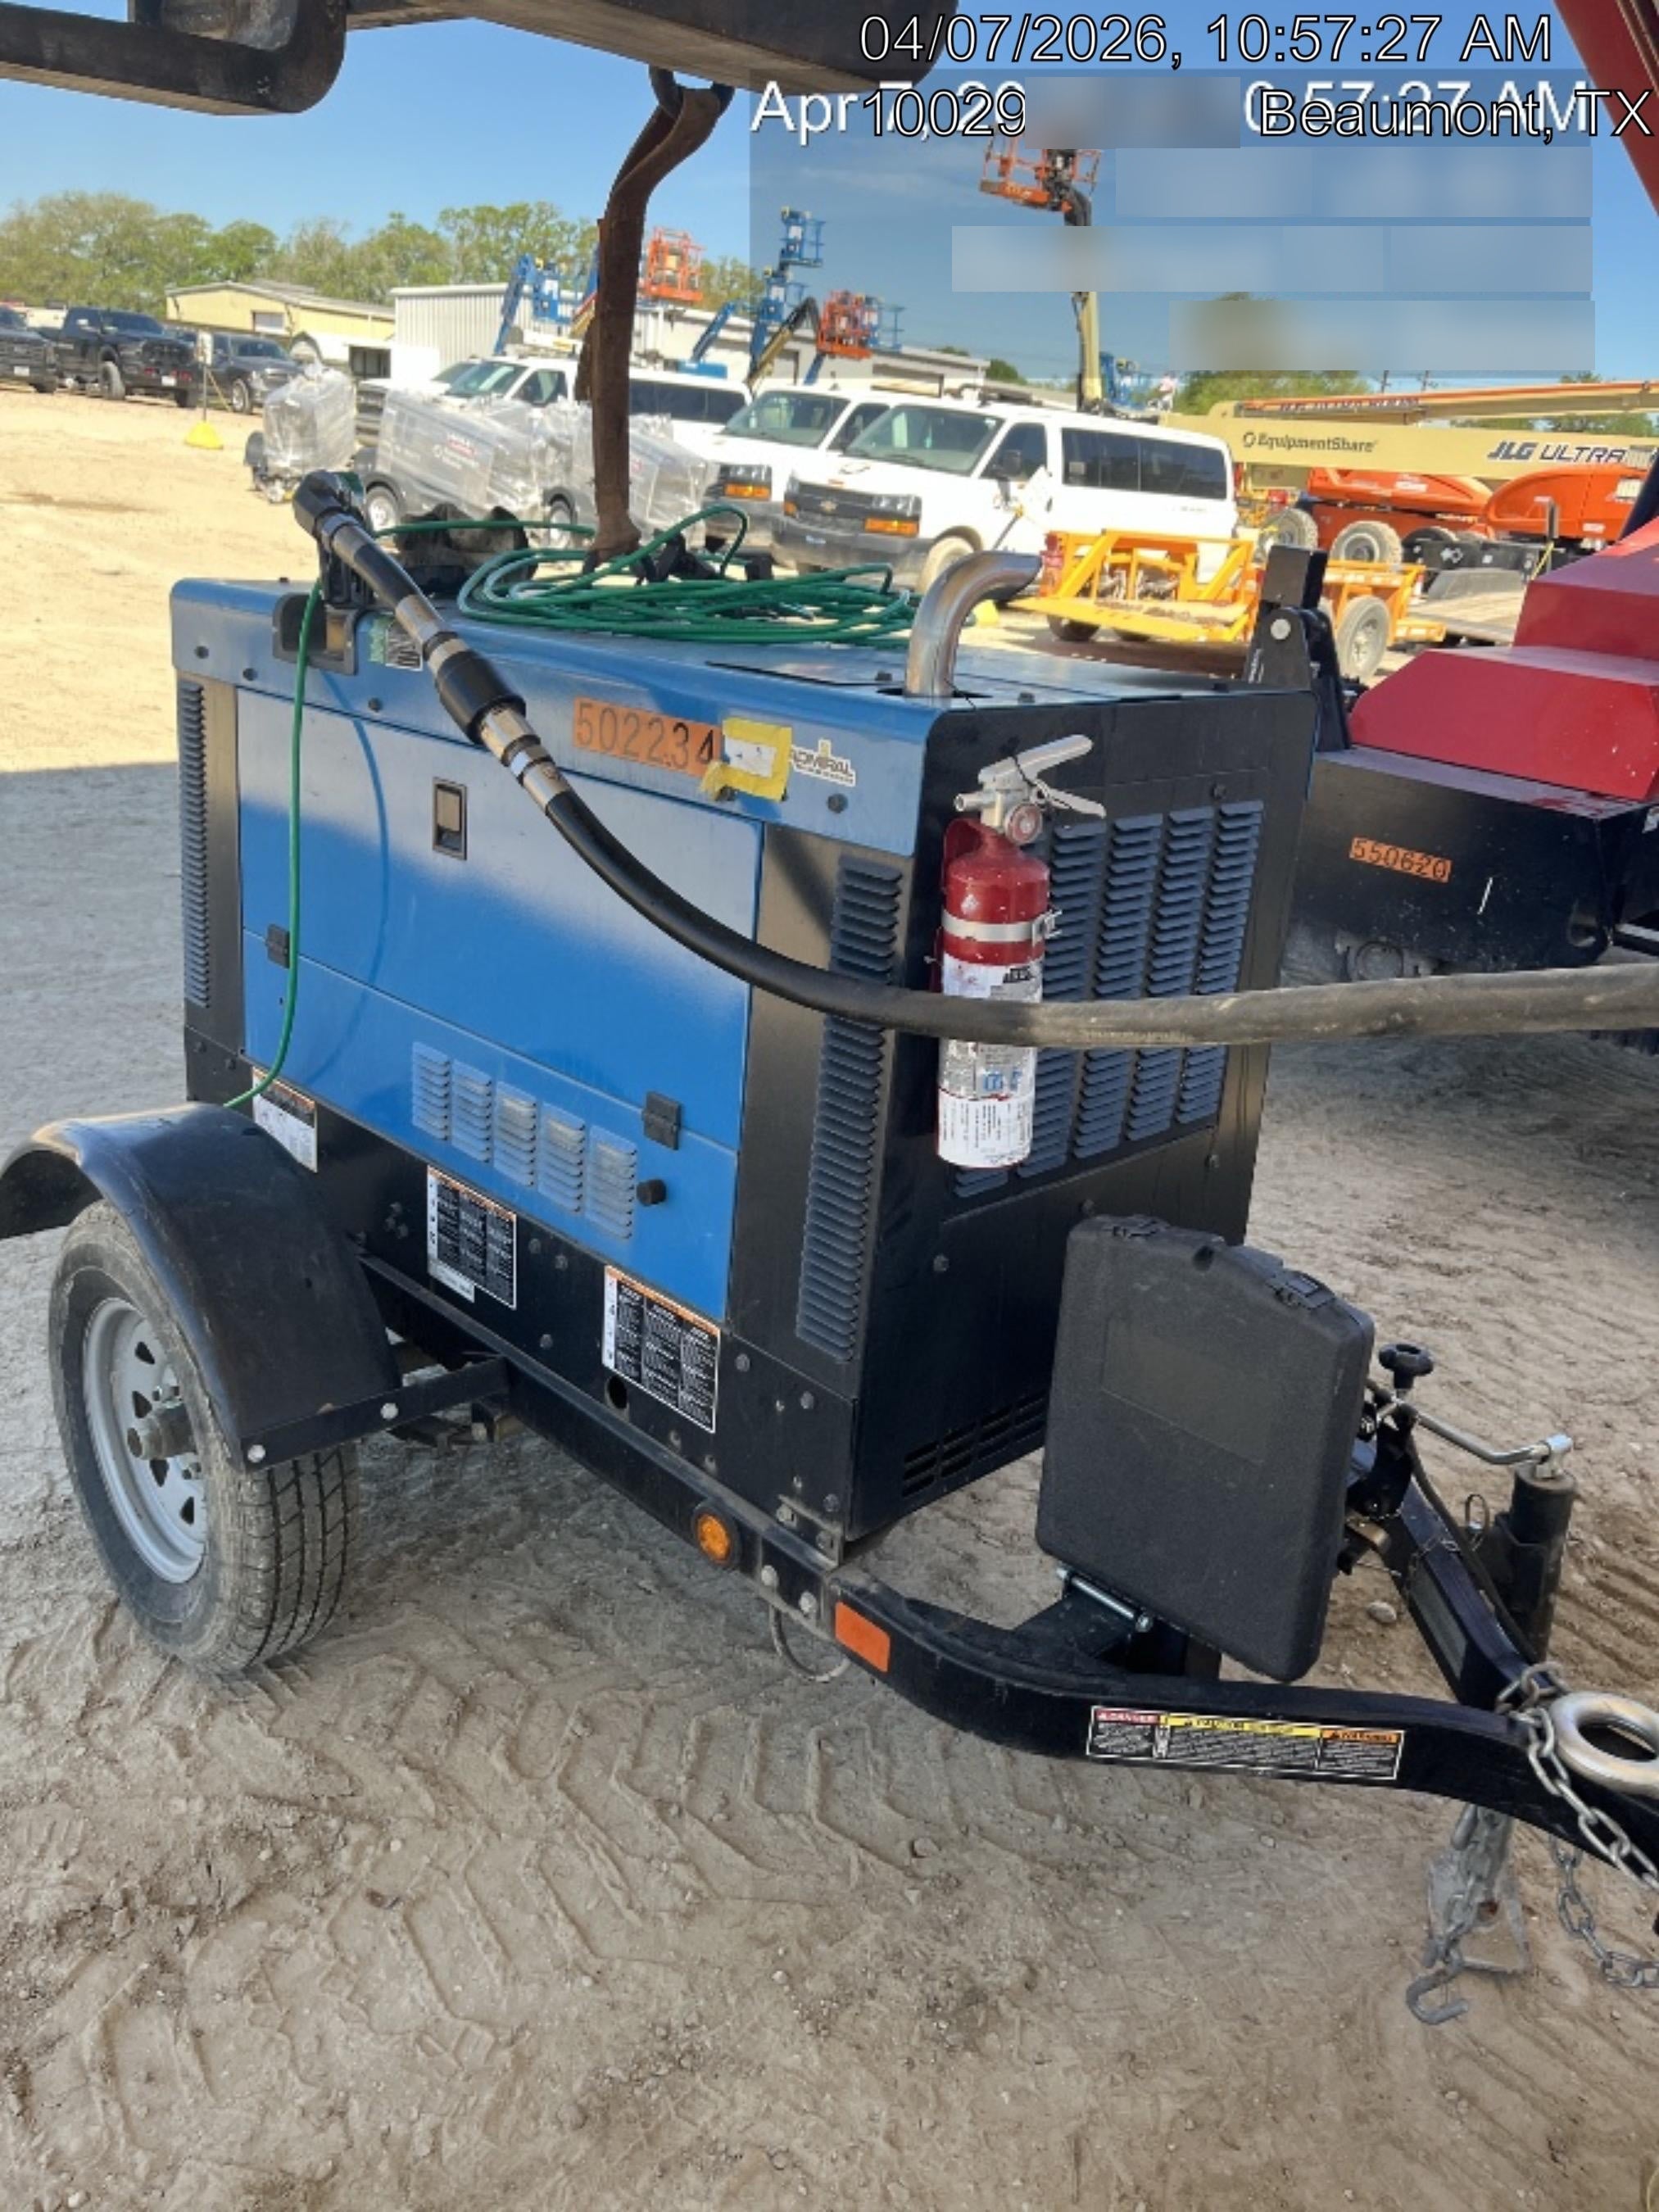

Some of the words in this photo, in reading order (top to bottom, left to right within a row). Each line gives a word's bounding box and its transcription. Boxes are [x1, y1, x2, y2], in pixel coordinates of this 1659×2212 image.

[1258, 433, 1375, 452] EquipmentShare
[1487, 440, 1539, 461] JLG
[1540, 444, 1627, 463] ULTRA
[576, 702, 714, 768] 502234
[1353, 839, 1448, 879] 550620
